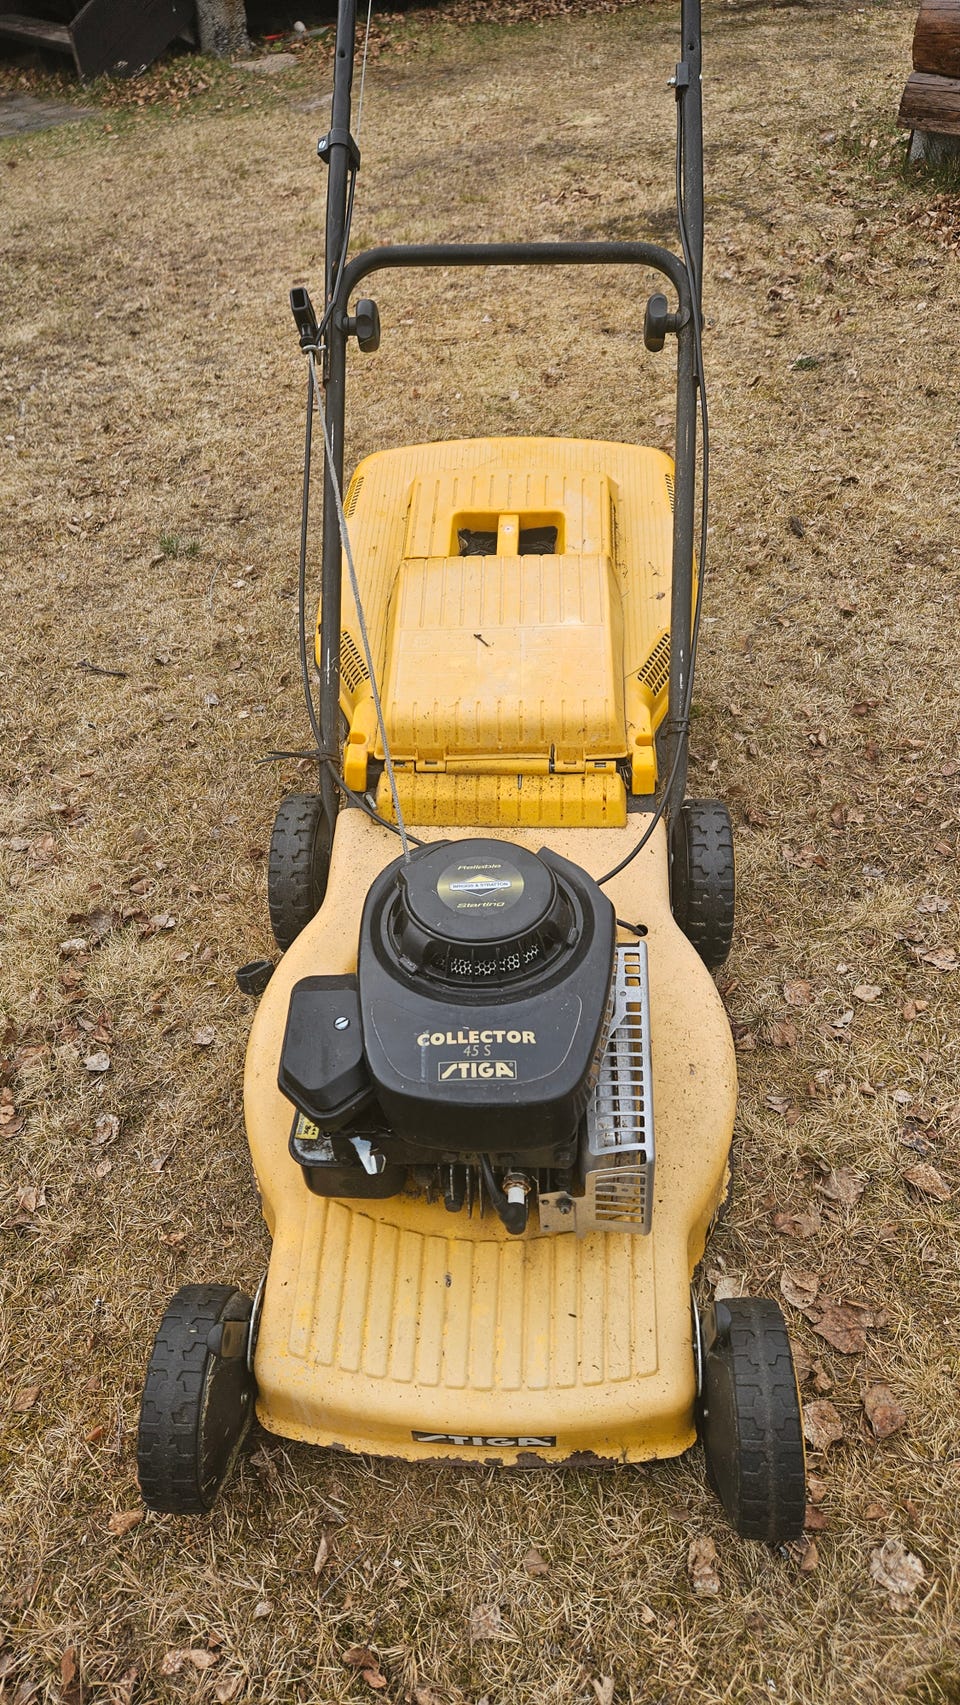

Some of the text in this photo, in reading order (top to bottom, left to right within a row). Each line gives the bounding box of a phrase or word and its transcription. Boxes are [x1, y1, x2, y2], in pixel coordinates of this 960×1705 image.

[456, 901, 505, 909] Starting
[416, 1029, 537, 1047] COLLECTOR
[463, 1044, 492, 1057] 45 S
[441, 1062, 515, 1080] STIGA
[417, 1434, 552, 1447] STIGA
